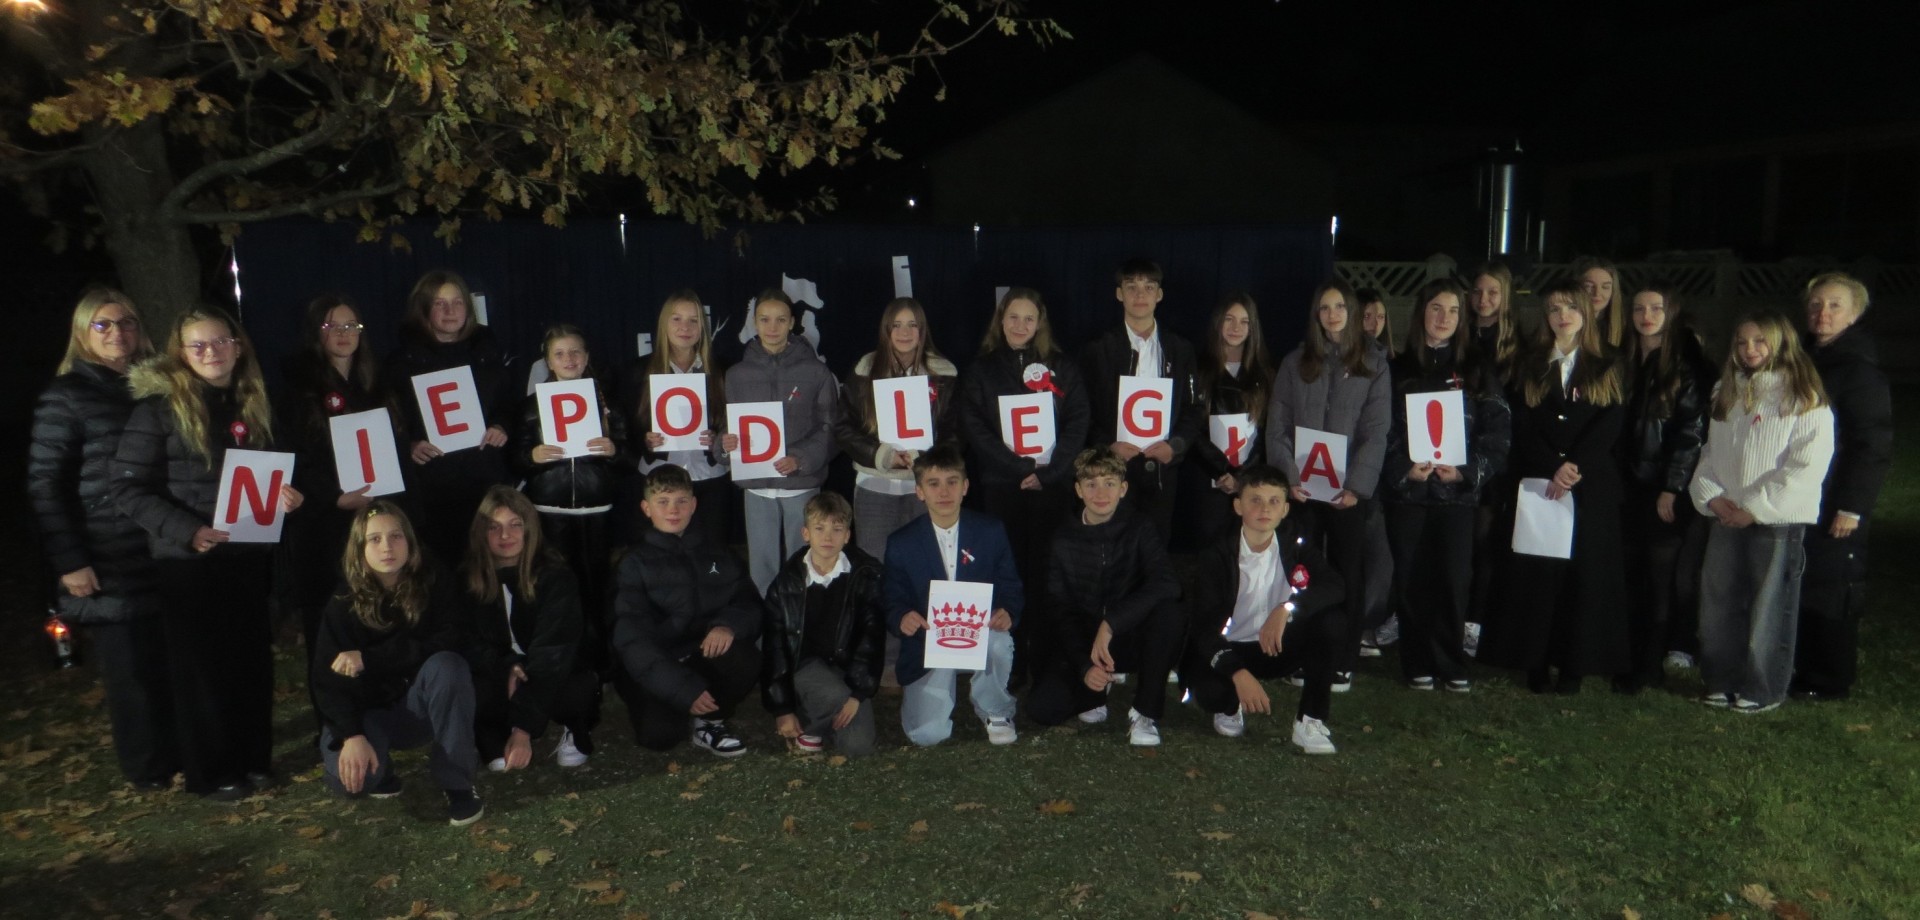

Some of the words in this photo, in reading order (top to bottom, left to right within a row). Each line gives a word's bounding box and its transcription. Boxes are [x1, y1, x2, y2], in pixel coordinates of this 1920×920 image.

[428, 383, 468, 435] E
[551, 393, 587, 442] P
[656, 387, 702, 436] O
[895, 391, 924, 439] L
[1012, 406, 1043, 456] E
[1123, 390, 1163, 438] G
[1427, 400, 1443, 459] !
[358, 430, 375, 483] I
[740, 416, 780, 463] D
[1300, 442, 1340, 489] A
[226, 466, 283, 525] N
